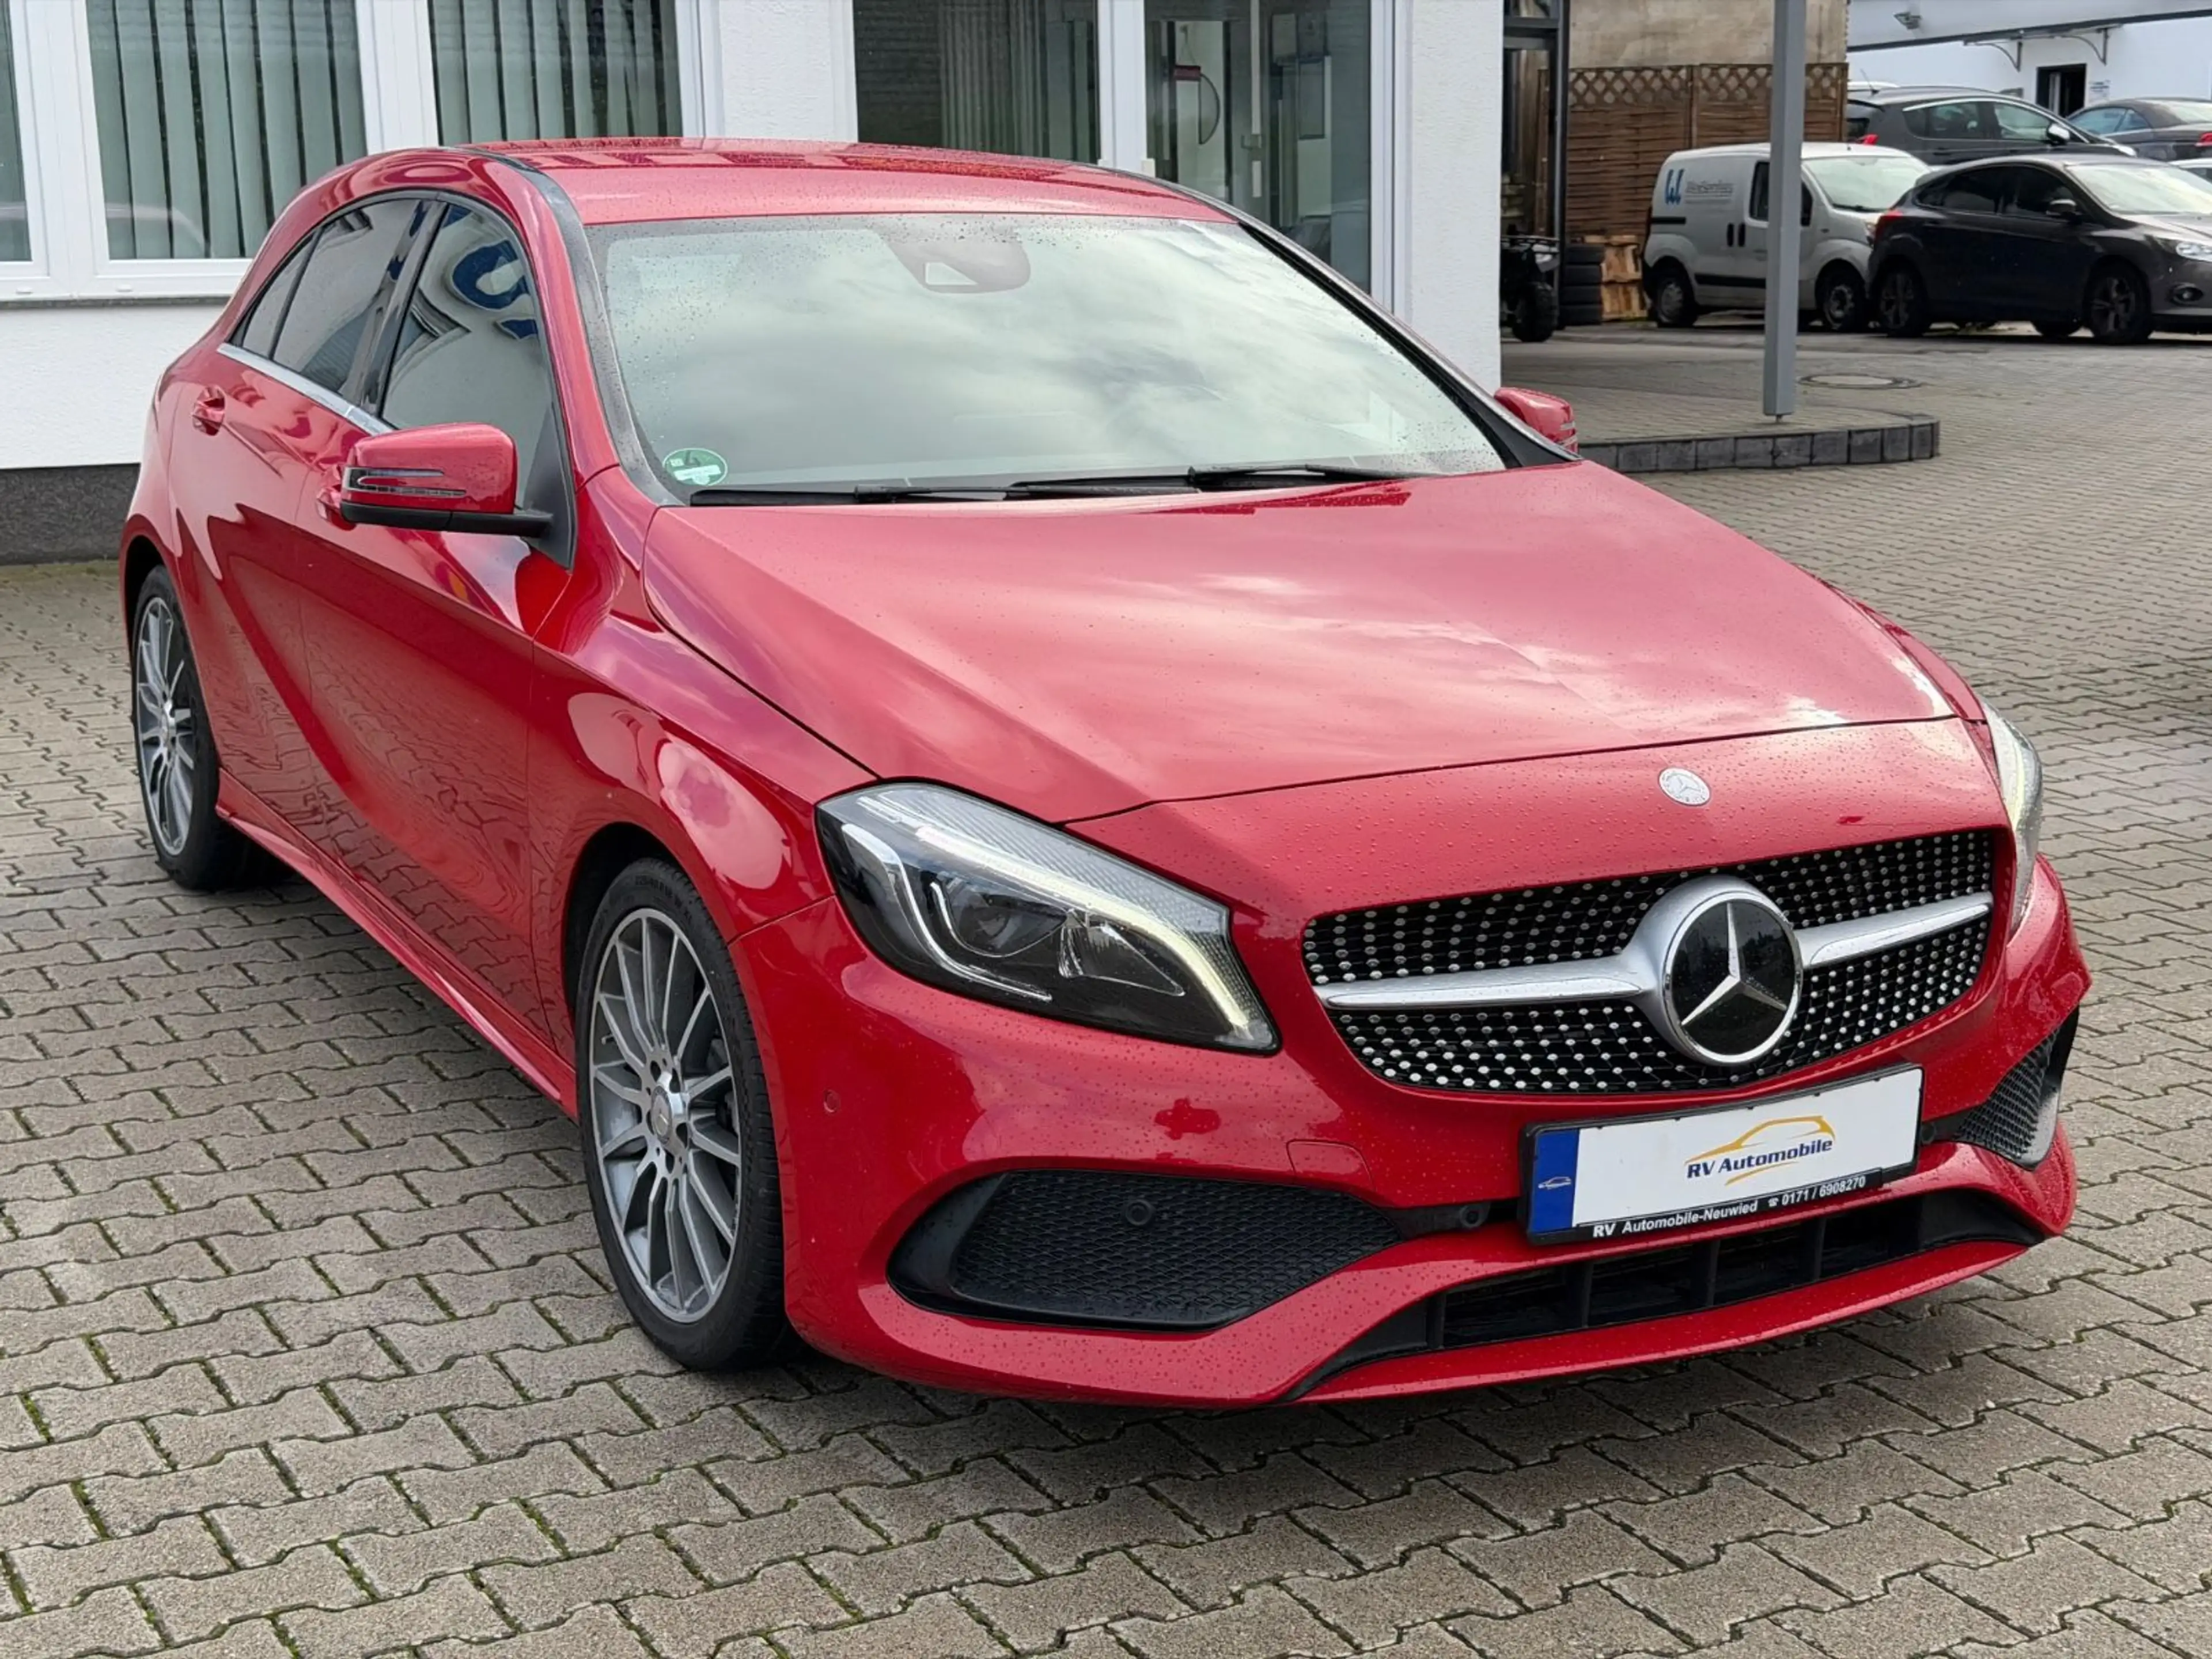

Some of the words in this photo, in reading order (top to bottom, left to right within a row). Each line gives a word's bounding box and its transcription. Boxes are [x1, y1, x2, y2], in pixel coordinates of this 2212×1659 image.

[1687, 1160, 1715, 1179] RV
[1718, 1139, 1833, 1173] Automobile
[1593, 1222, 1616, 1237] RV
[1622, 1200, 1758, 1234] Automobile-Neuwied
[1781, 1190, 1809, 1206] 0171
[1819, 1176, 1866, 1197] 6908270
